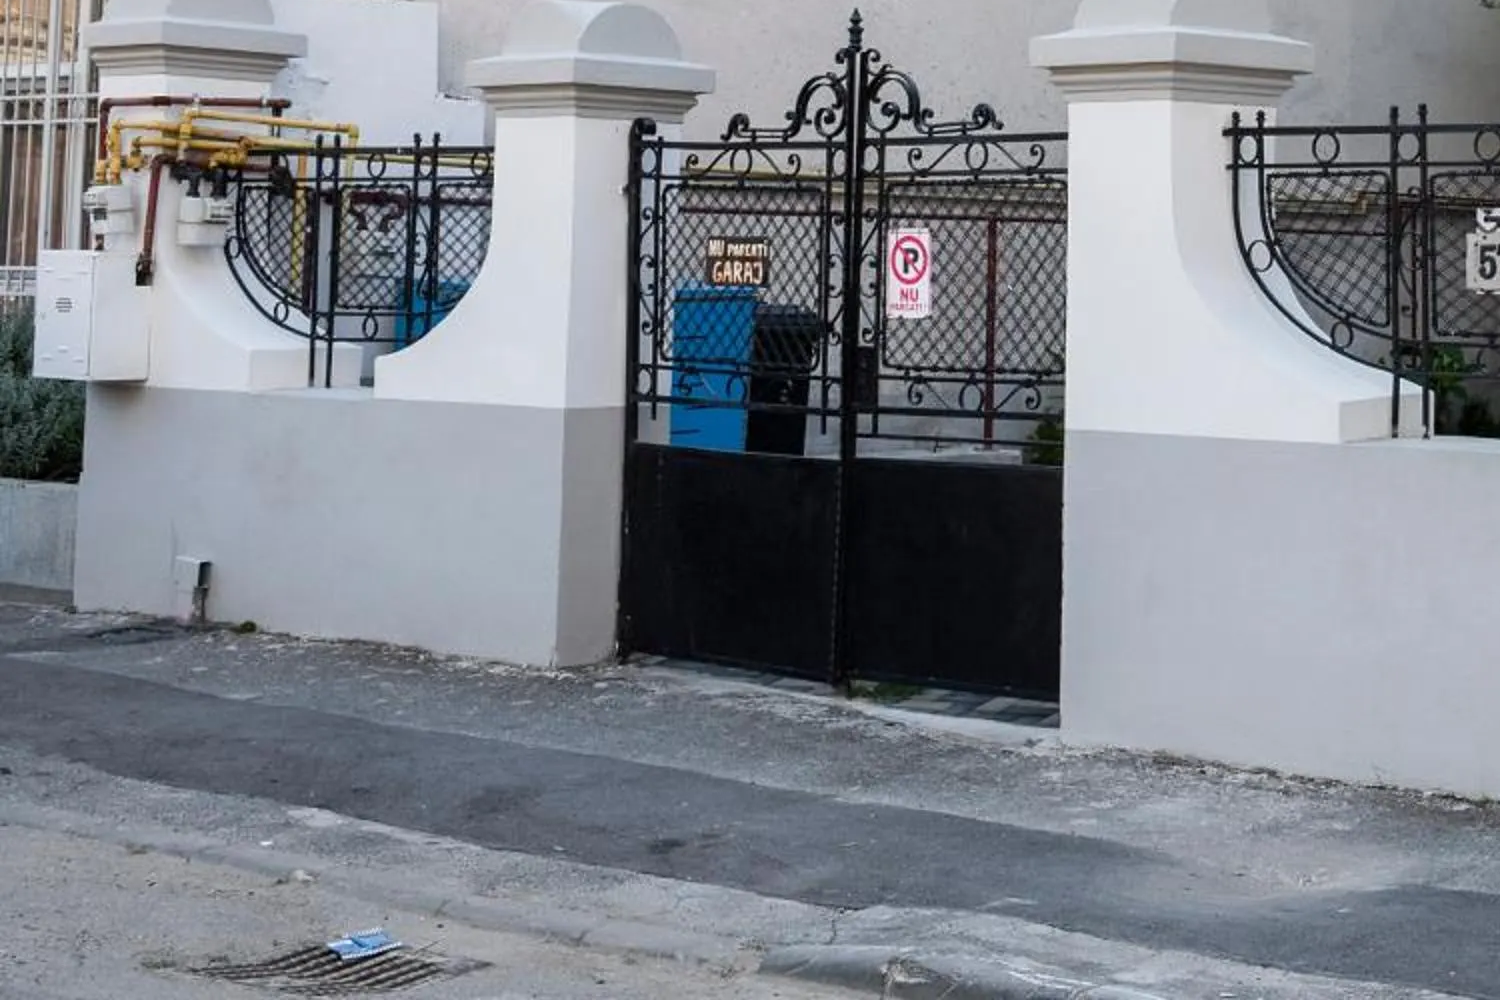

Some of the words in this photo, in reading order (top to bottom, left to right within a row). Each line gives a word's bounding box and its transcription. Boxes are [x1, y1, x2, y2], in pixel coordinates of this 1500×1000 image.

[709, 240, 724, 256] NU
[903, 247, 918, 274] P
[712, 260, 763, 284] GARAJ
[900, 288, 918, 302] NU
